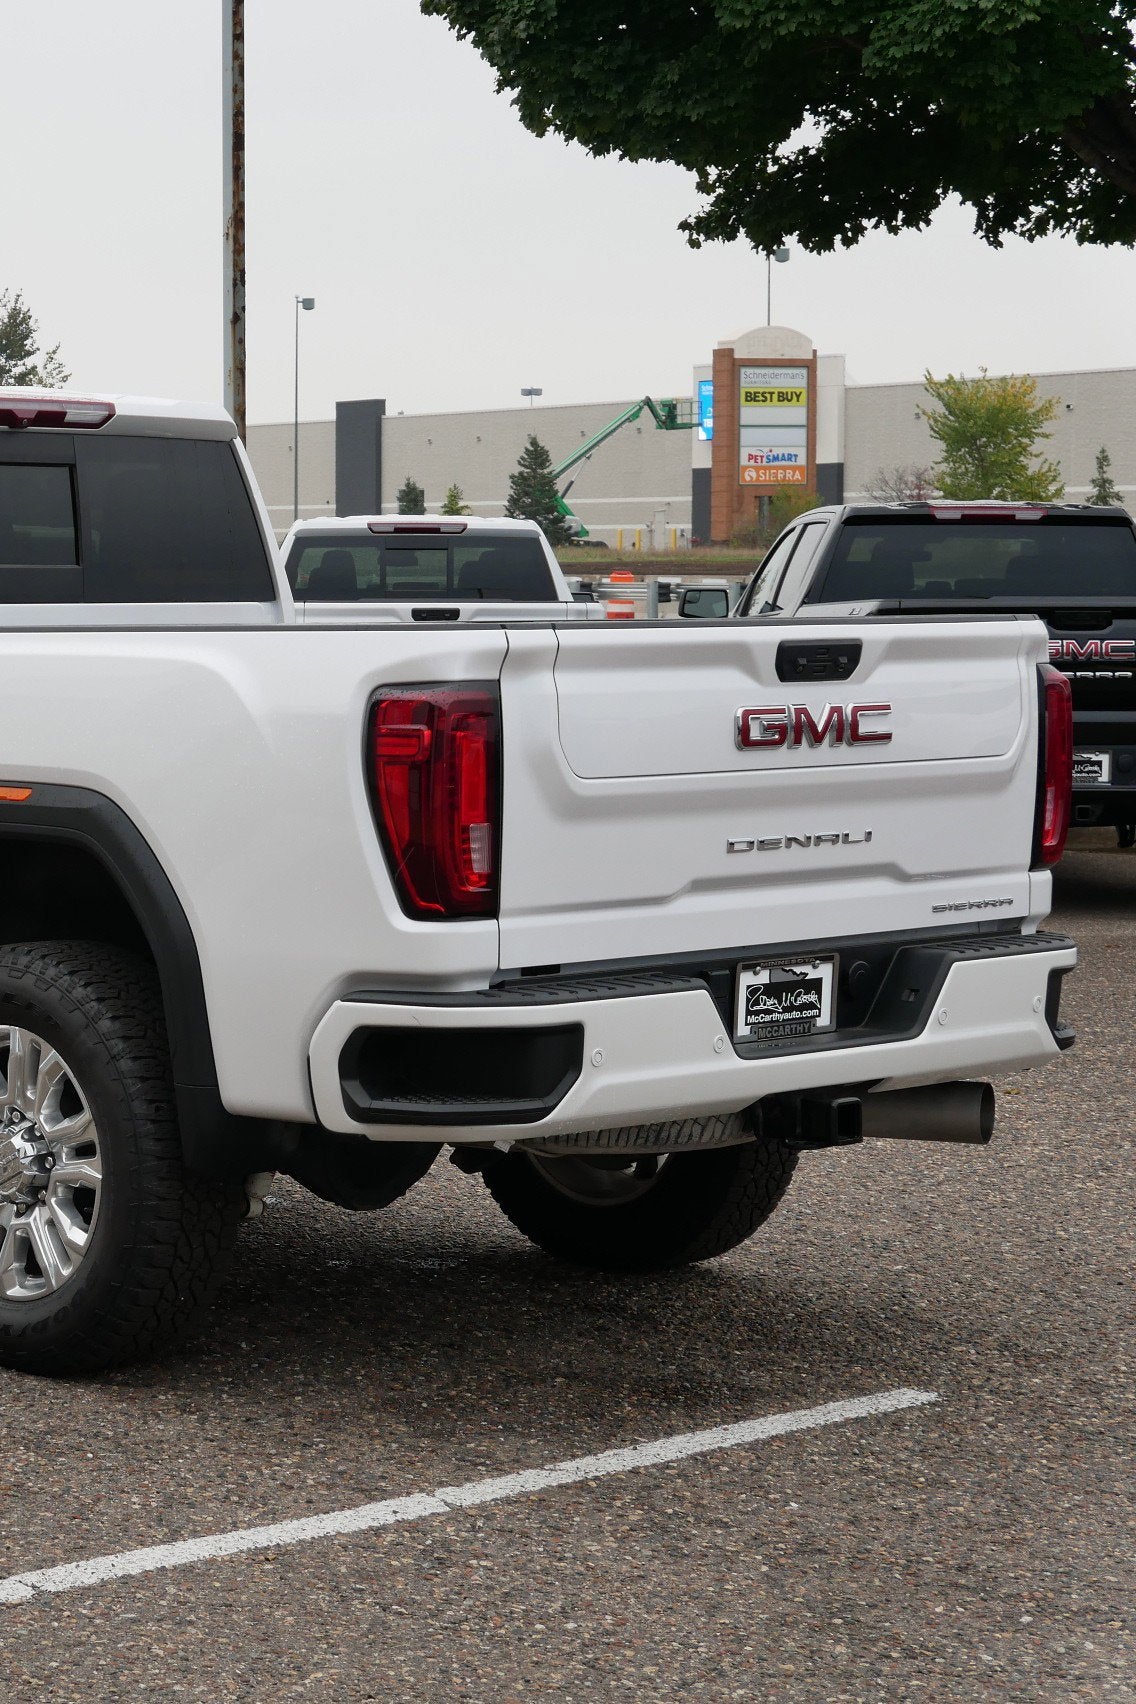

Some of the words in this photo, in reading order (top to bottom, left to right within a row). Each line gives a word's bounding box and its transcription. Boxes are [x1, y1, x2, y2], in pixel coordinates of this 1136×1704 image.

[743, 370, 805, 380] Schneiderman's
[744, 391, 775, 403] BEST
[777, 391, 803, 403] BUY
[759, 470, 802, 480] SIERRA
[734, 702, 893, 750] GMC
[726, 829, 873, 854] DENALI
[931, 898, 1014, 913] SIERRA
[747, 1009, 819, 1024] McCarthyauto.com
[758, 1021, 811, 1039] MCCARTHY
